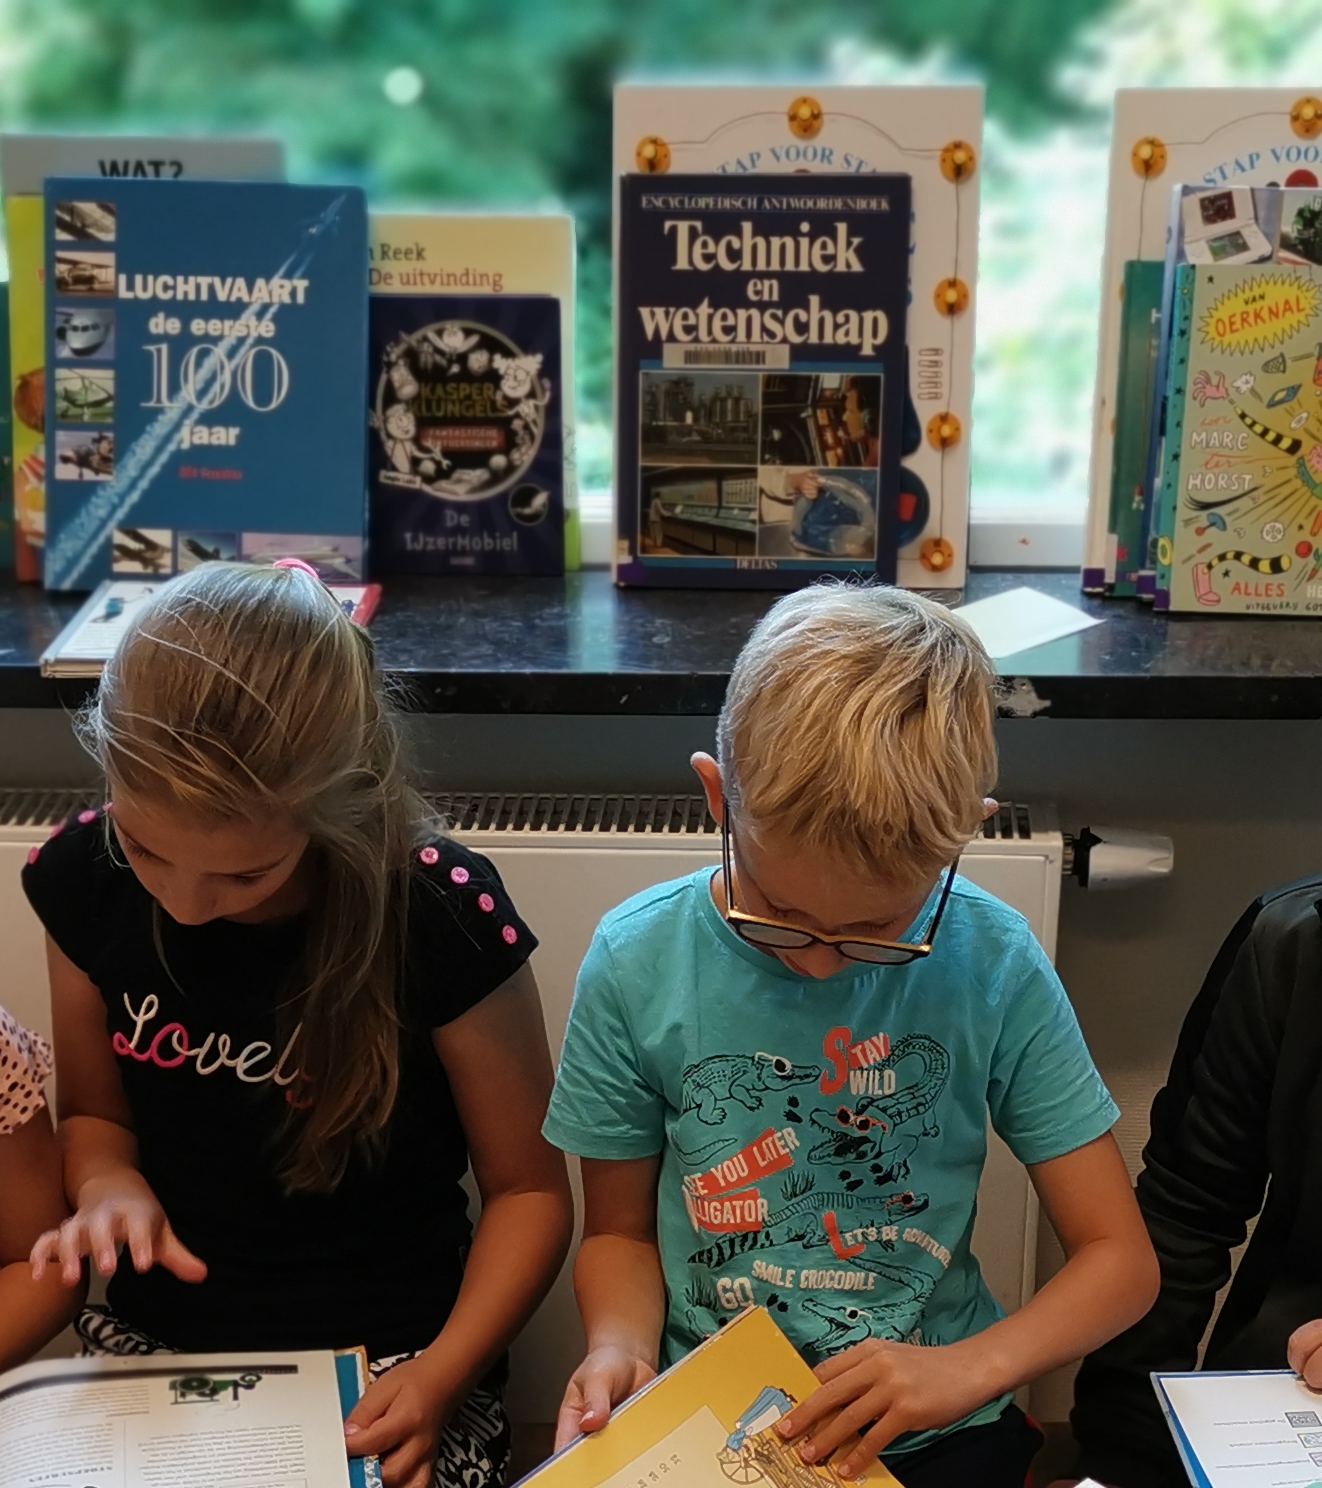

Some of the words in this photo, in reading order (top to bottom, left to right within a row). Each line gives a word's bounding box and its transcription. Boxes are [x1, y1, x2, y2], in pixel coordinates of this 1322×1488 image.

[770, 143, 835, 165] VOOR
[98, 158, 184, 178] WAT?
[1204, 150, 1262, 187] STAP
[641, 195, 759, 211] ENCYCLOPEDISCH
[761, 195, 890, 212] ANTWOORDENBOEK
[380, 243, 427, 261] Reek
[664, 219, 864, 273] Techniek
[118, 273, 310, 305] LUCHTVAART
[368, 268, 394, 287] De
[398, 268, 505, 292] uitvinding
[746, 276, 779, 302] en
[1242, 291, 1266, 306] VAN
[148, 312, 182, 336] de
[190, 317, 277, 339] eerste
[638, 295, 889, 357] wetenschap
[1213, 294, 1307, 339] OERKNAL
[139, 342, 291, 411] 100
[420, 383, 496, 400] KASPER
[407, 400, 510, 418] KLUNGELS
[179, 418, 240, 449] jaar
[1190, 431, 1250, 451] MARC
[1186, 472, 1254, 492] HORST
[445, 508, 472, 527] De
[1229, 581, 1287, 600] ALLES
[849, 1068, 897, 1096] WILD
[710, 1153, 750, 1188] YOU
[881, 1225, 899, 1242] BE
[751, 1259, 795, 1289] SMILE
[799, 1266, 878, 1292] CROCODILE
